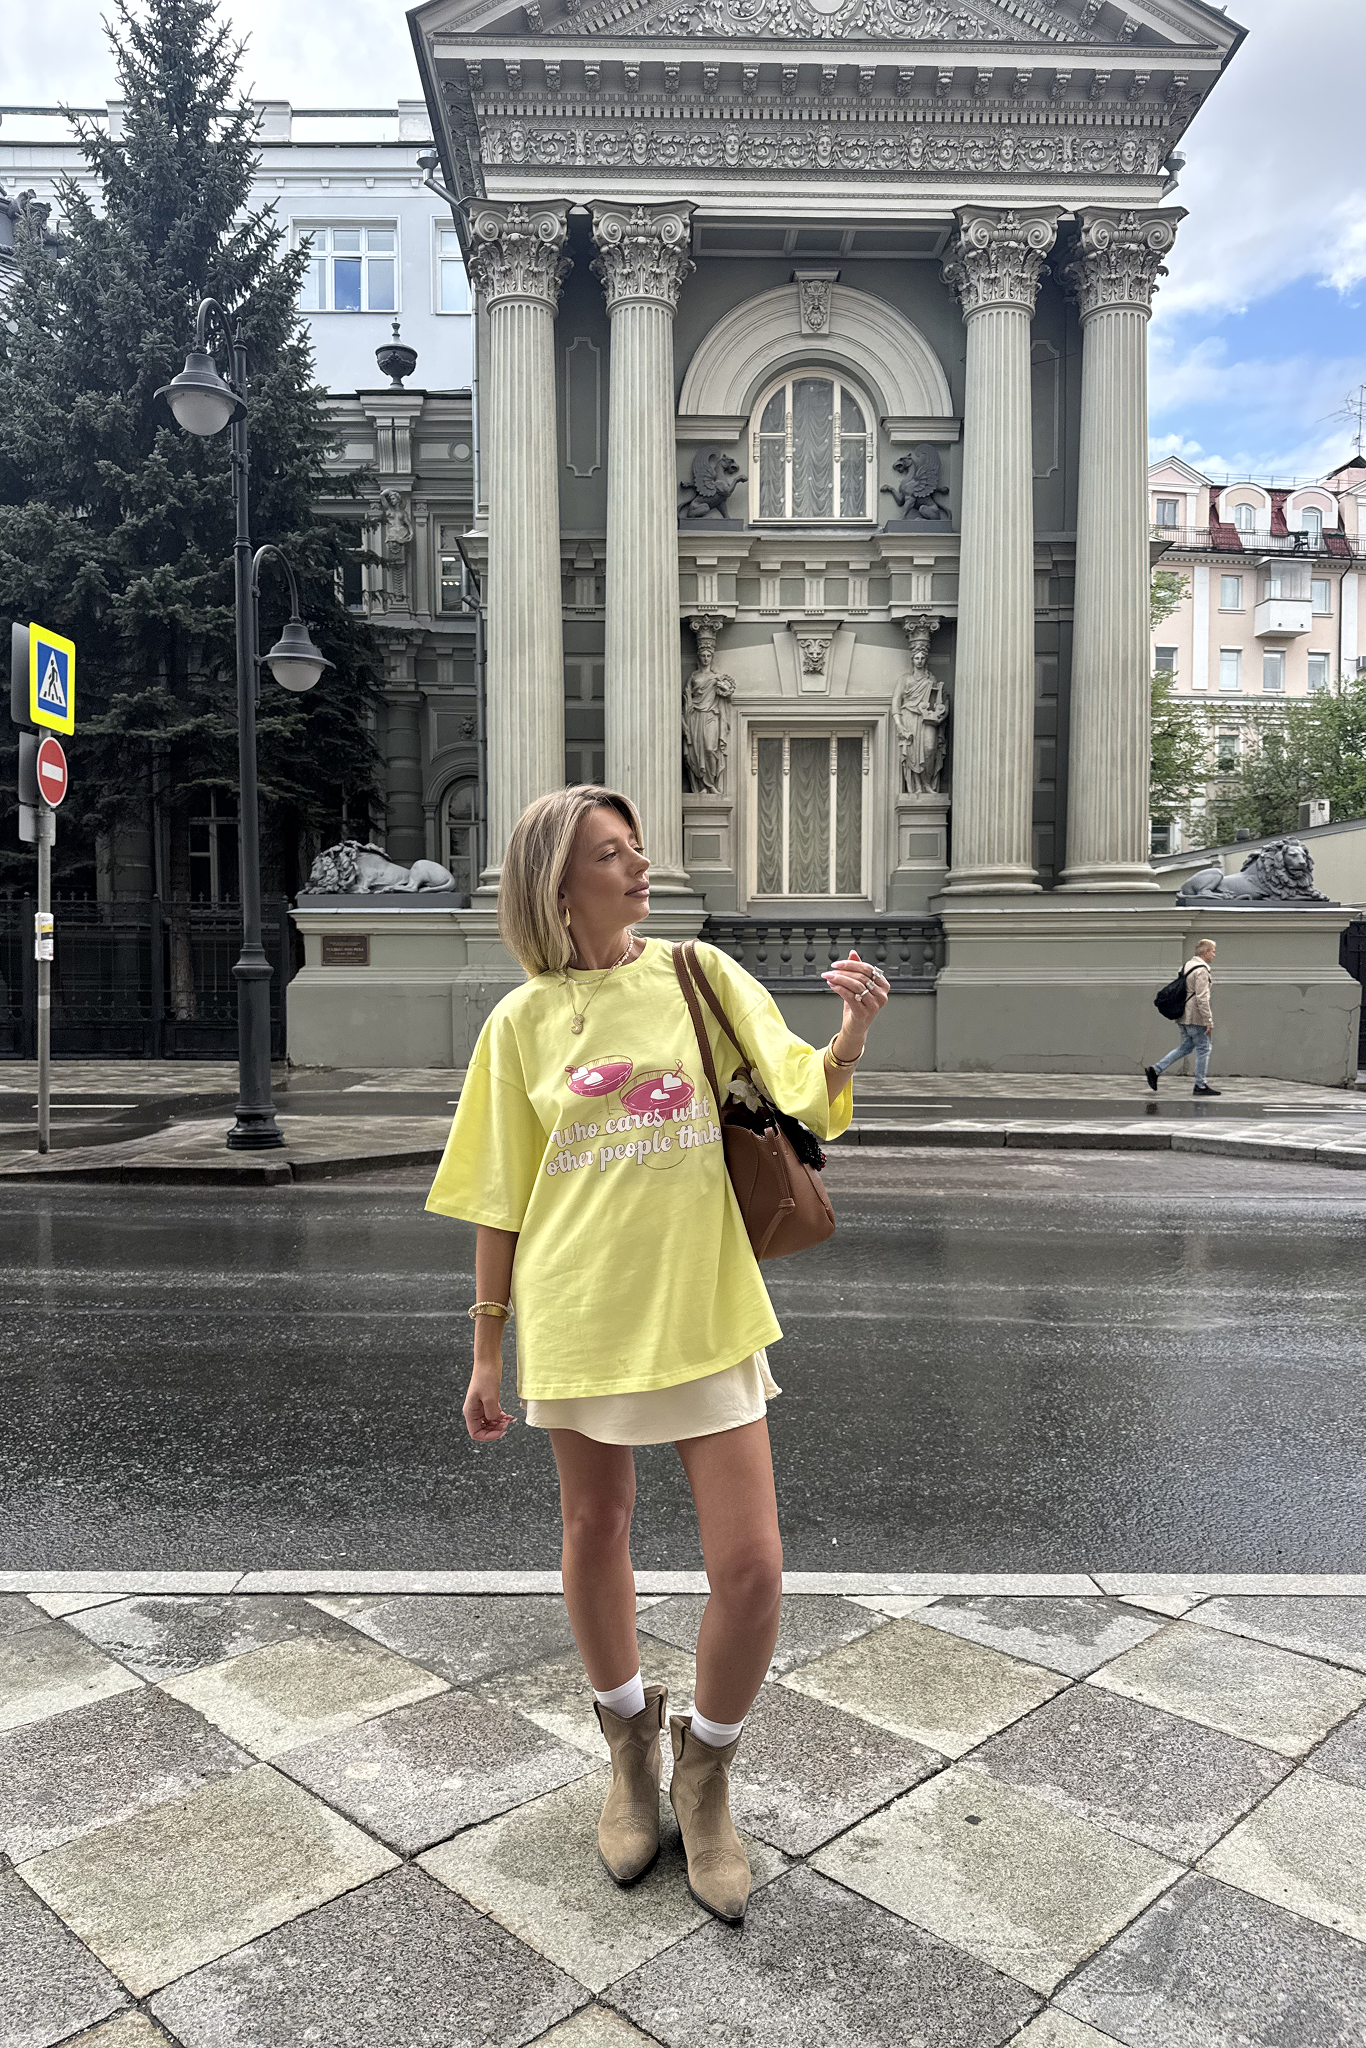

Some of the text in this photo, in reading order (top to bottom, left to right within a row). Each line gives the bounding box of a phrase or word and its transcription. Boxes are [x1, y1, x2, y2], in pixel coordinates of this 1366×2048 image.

[550, 1121, 601, 1148] Who
[605, 1108, 666, 1134] cares
[546, 1149, 595, 1176] other
[598, 1130, 674, 1172] people
